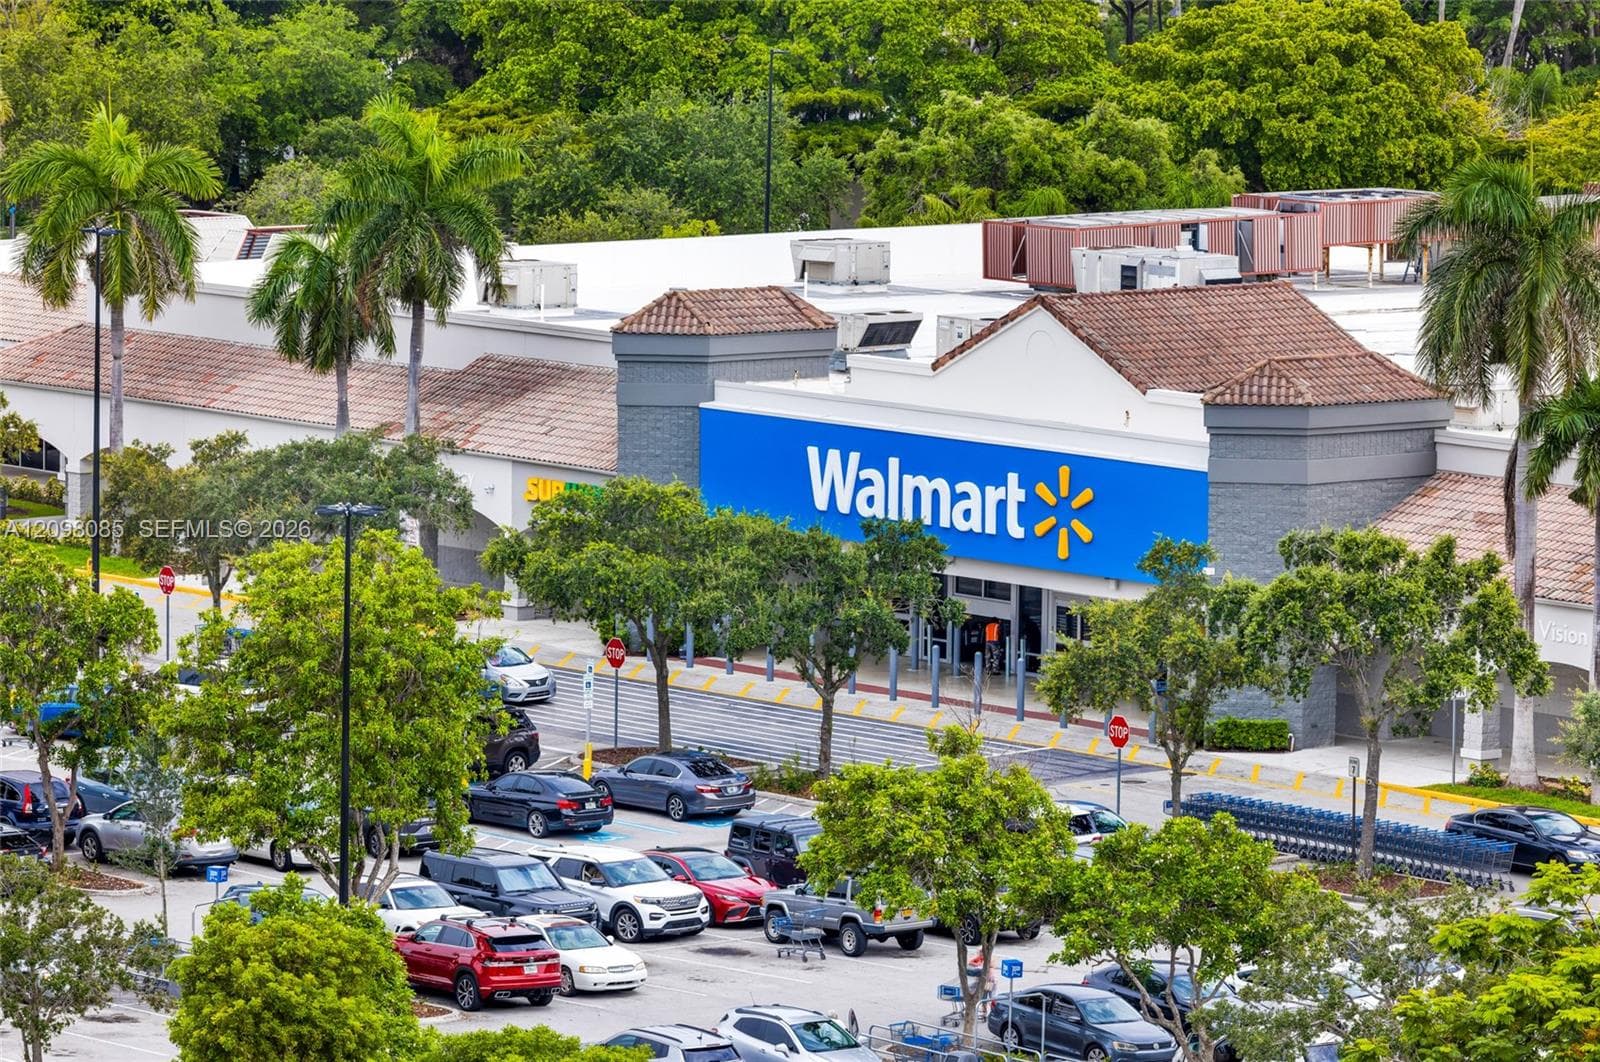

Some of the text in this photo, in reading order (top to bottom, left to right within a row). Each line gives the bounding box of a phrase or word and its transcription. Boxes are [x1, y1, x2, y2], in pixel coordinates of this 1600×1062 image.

[806, 445, 1027, 539] Walmart
[159, 574, 175, 587] STOP
[1537, 619, 1589, 647] Vision
[607, 646, 625, 661] STOP
[1109, 724, 1129, 739] STOP
